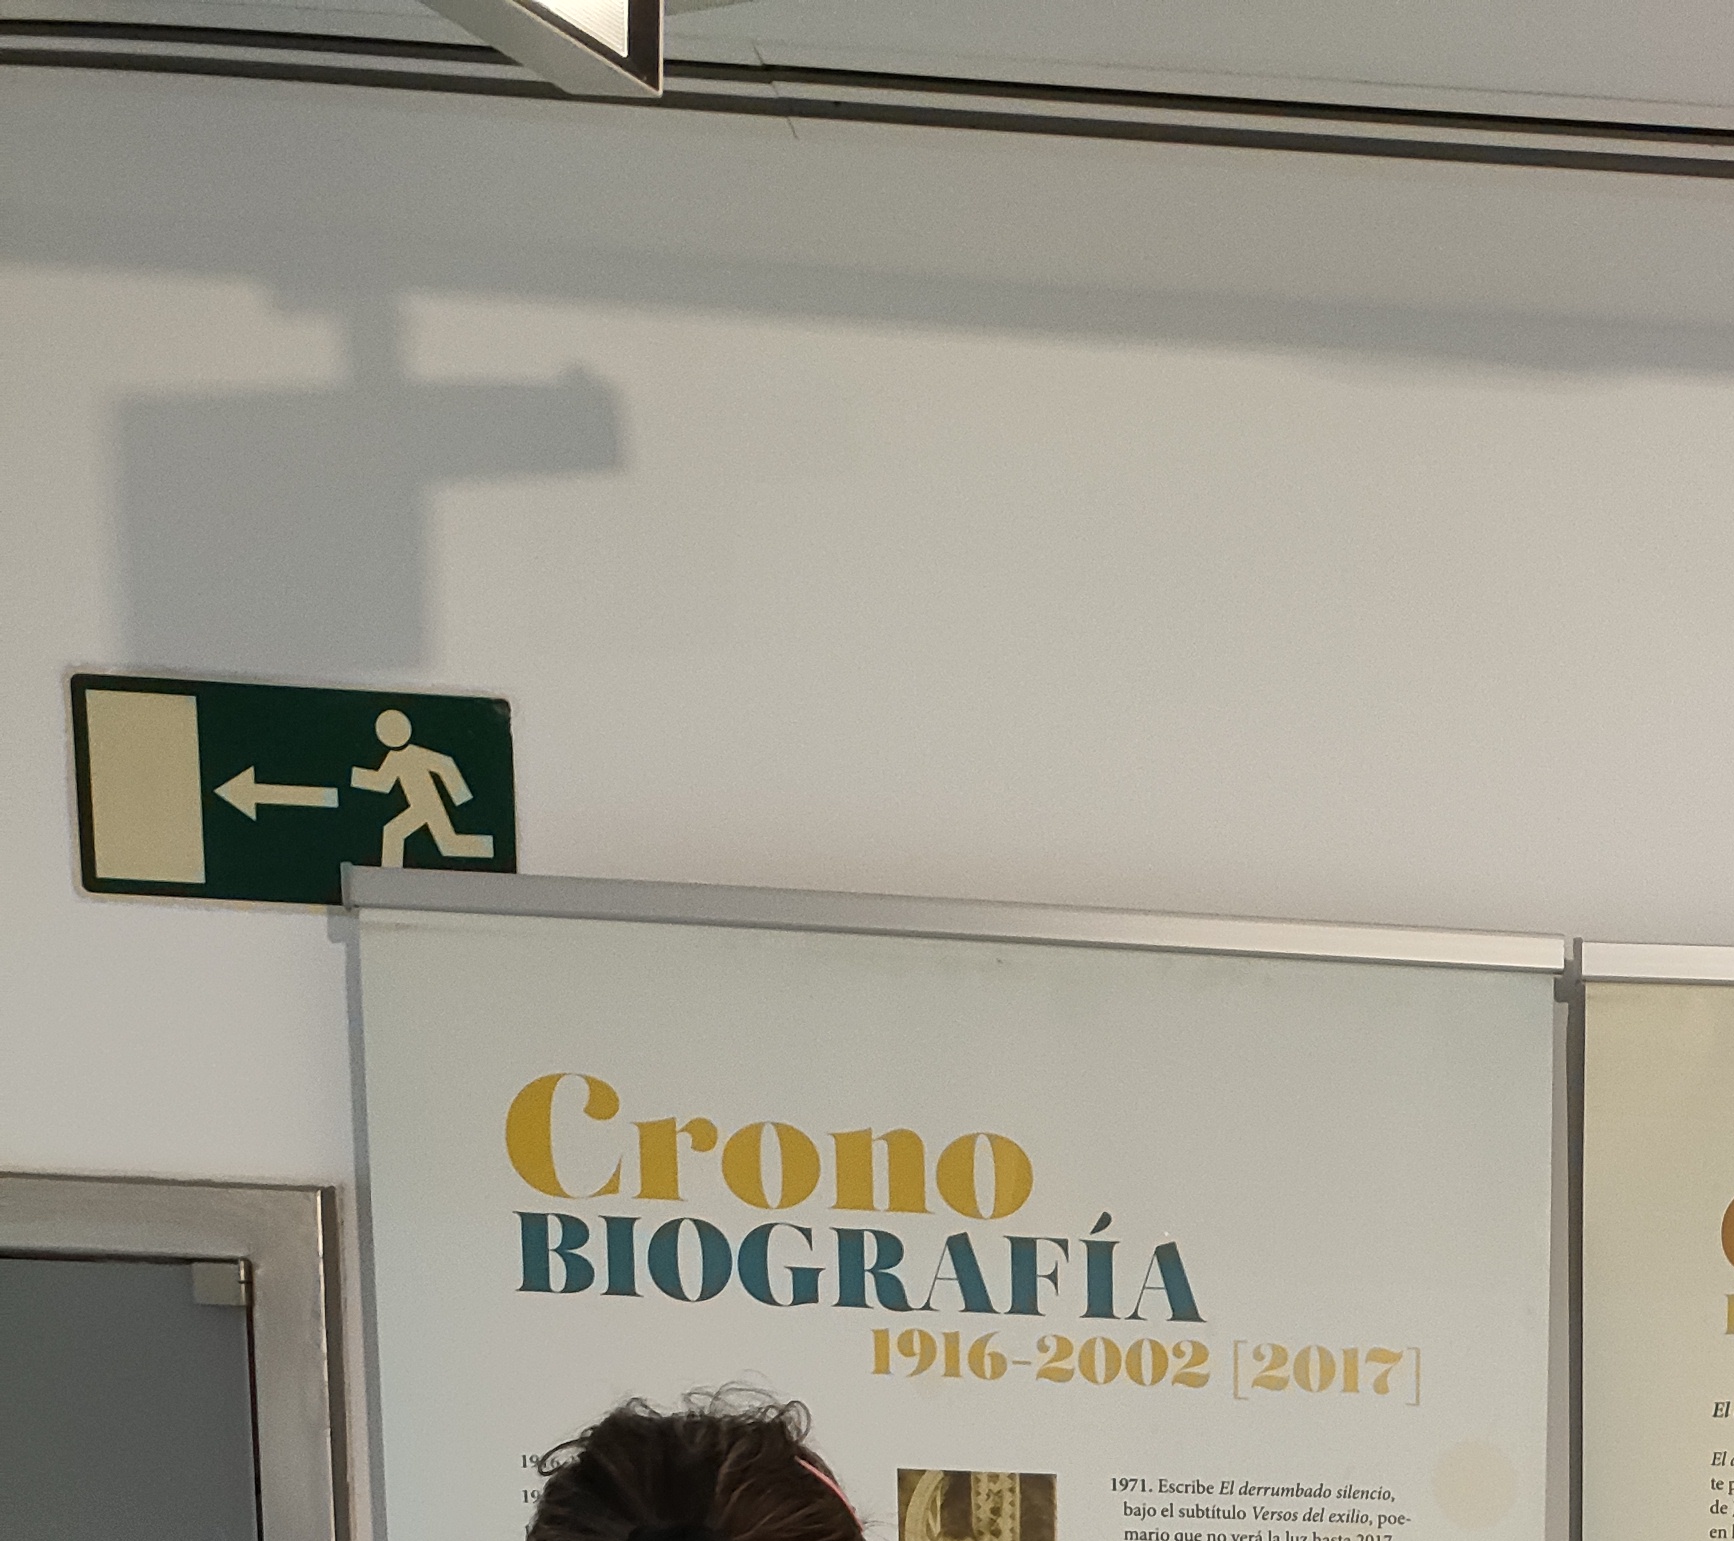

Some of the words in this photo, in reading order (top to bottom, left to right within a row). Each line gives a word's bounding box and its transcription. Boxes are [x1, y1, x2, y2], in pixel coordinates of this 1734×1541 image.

[505, 1073, 1034, 1220] Crono
[515, 1212, 1206, 1323] BIOGRAFÍA
[871, 1328, 1210, 1389] 1916-2002
[1233, 1338, 1421, 1406] [2017]
[1711, 1400, 1732, 1419] El
[1111, 1477, 1154, 1493] 1971.
[1157, 1478, 1215, 1495] Escribe
[1218, 1479, 1235, 1496] El
[1238, 1480, 1332, 1499] derrumbado
[1335, 1483, 1396, 1503] silencio,
[1123, 1500, 1157, 1522] bajo
[1160, 1502, 1175, 1519] el
[1178, 1502, 1247, 1521] subtítulo
[1252, 1505, 1299, 1523] Versos
[1301, 1506, 1326, 1523] del
[1328, 1507, 1373, 1527] exilio,
[1377, 1513, 1412, 1530] poe-
